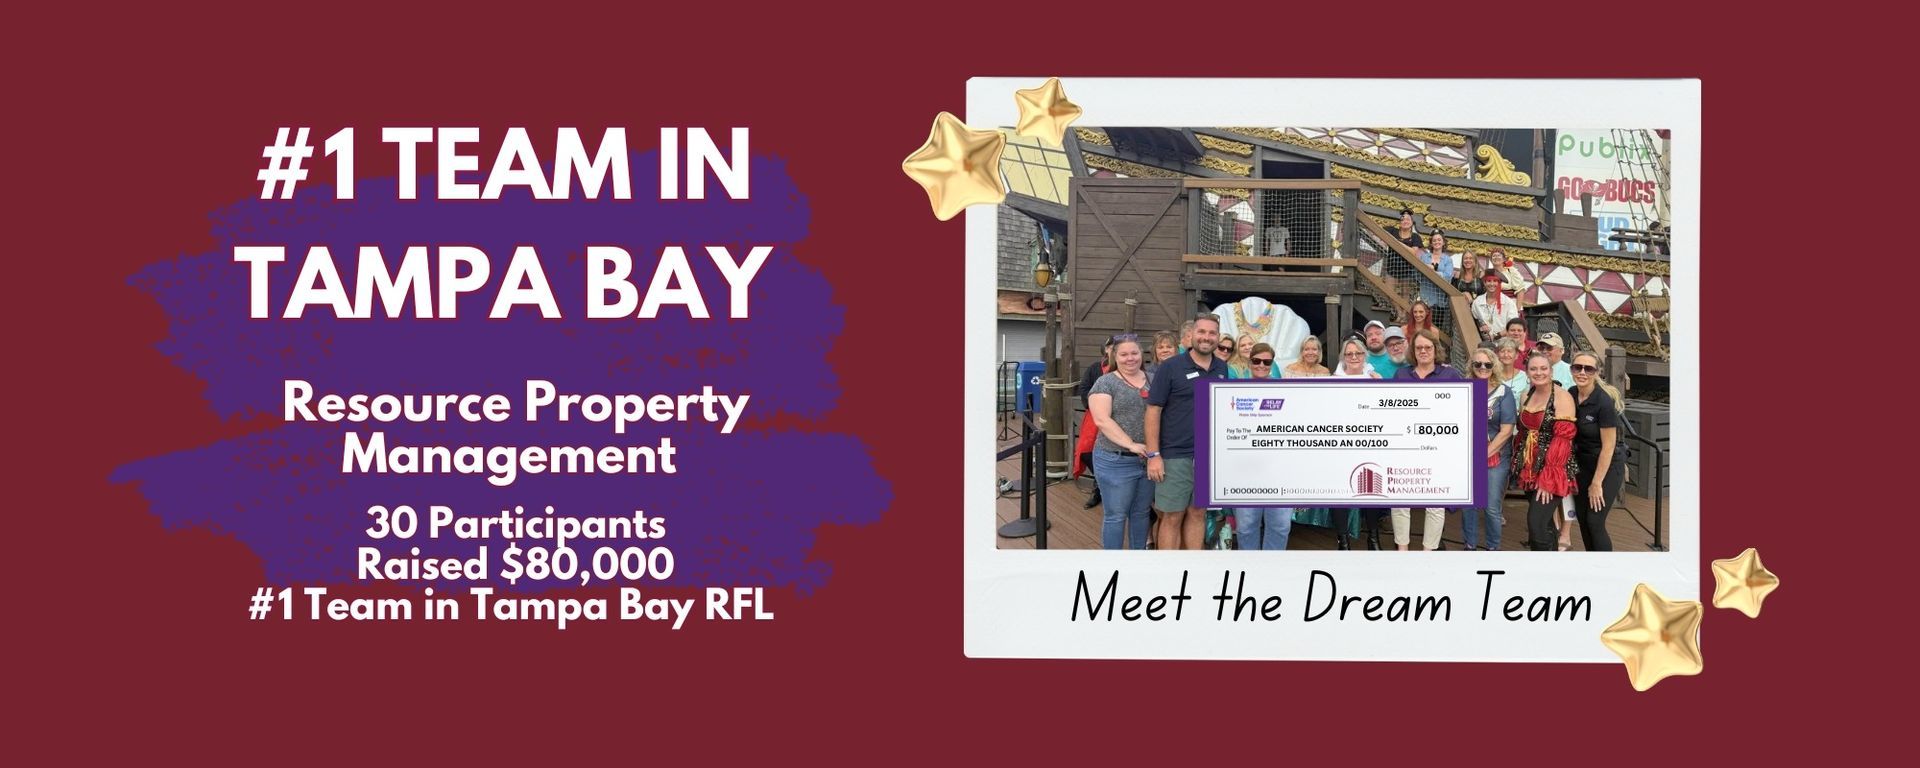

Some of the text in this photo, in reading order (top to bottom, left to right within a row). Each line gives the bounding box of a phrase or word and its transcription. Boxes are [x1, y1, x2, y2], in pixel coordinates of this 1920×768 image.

[1558, 134, 1652, 160] Publix
[1558, 176, 1656, 204] GO BUCS
[1378, 398, 1419, 408] 3/8/2025
[1256, 424, 1384, 433] AMERICAN CANCER SOCIETY
[1406, 425, 1459, 437] $ 80,000
[1251, 439, 1389, 448] EIGHTY THOUSAND AN 00/100
[1387, 467, 1432, 475] RESOURCE
[1387, 477, 1432, 485] PROPERTY
[1387, 486, 1451, 494] MANAGEMENT
